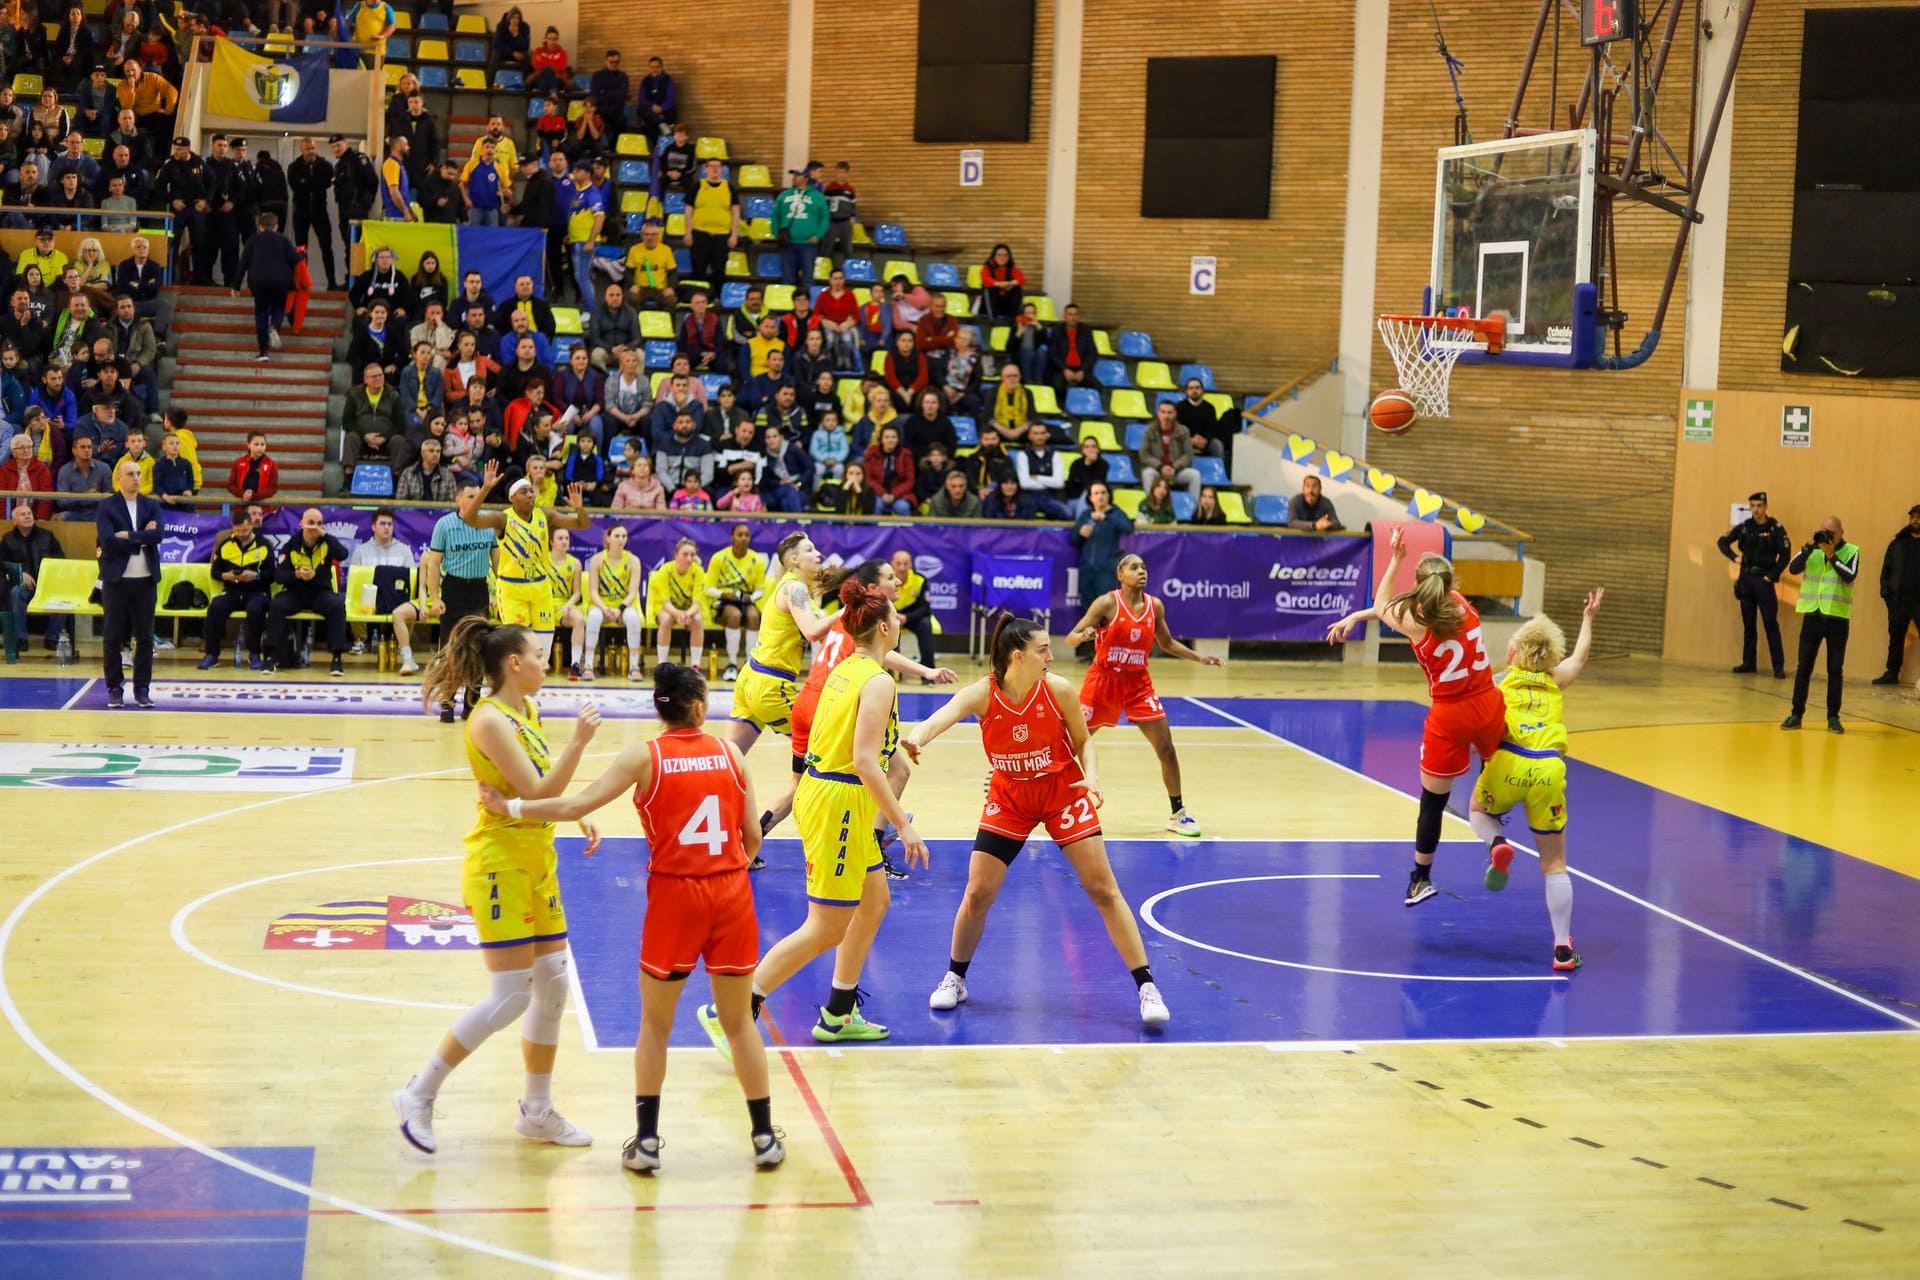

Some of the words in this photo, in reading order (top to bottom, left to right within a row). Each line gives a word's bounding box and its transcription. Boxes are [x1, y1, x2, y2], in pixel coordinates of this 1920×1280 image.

[964, 162, 979, 183] D
[1194, 269, 1212, 291] C
[992, 575, 1043, 590] molten
[1269, 563, 1360, 580] Icetech
[1163, 578, 1250, 601] Optimall
[1433, 627, 1490, 682] 23
[29, 752, 343, 777] FCC
[678, 795, 729, 856] 4
[1059, 797, 1094, 831] 32
